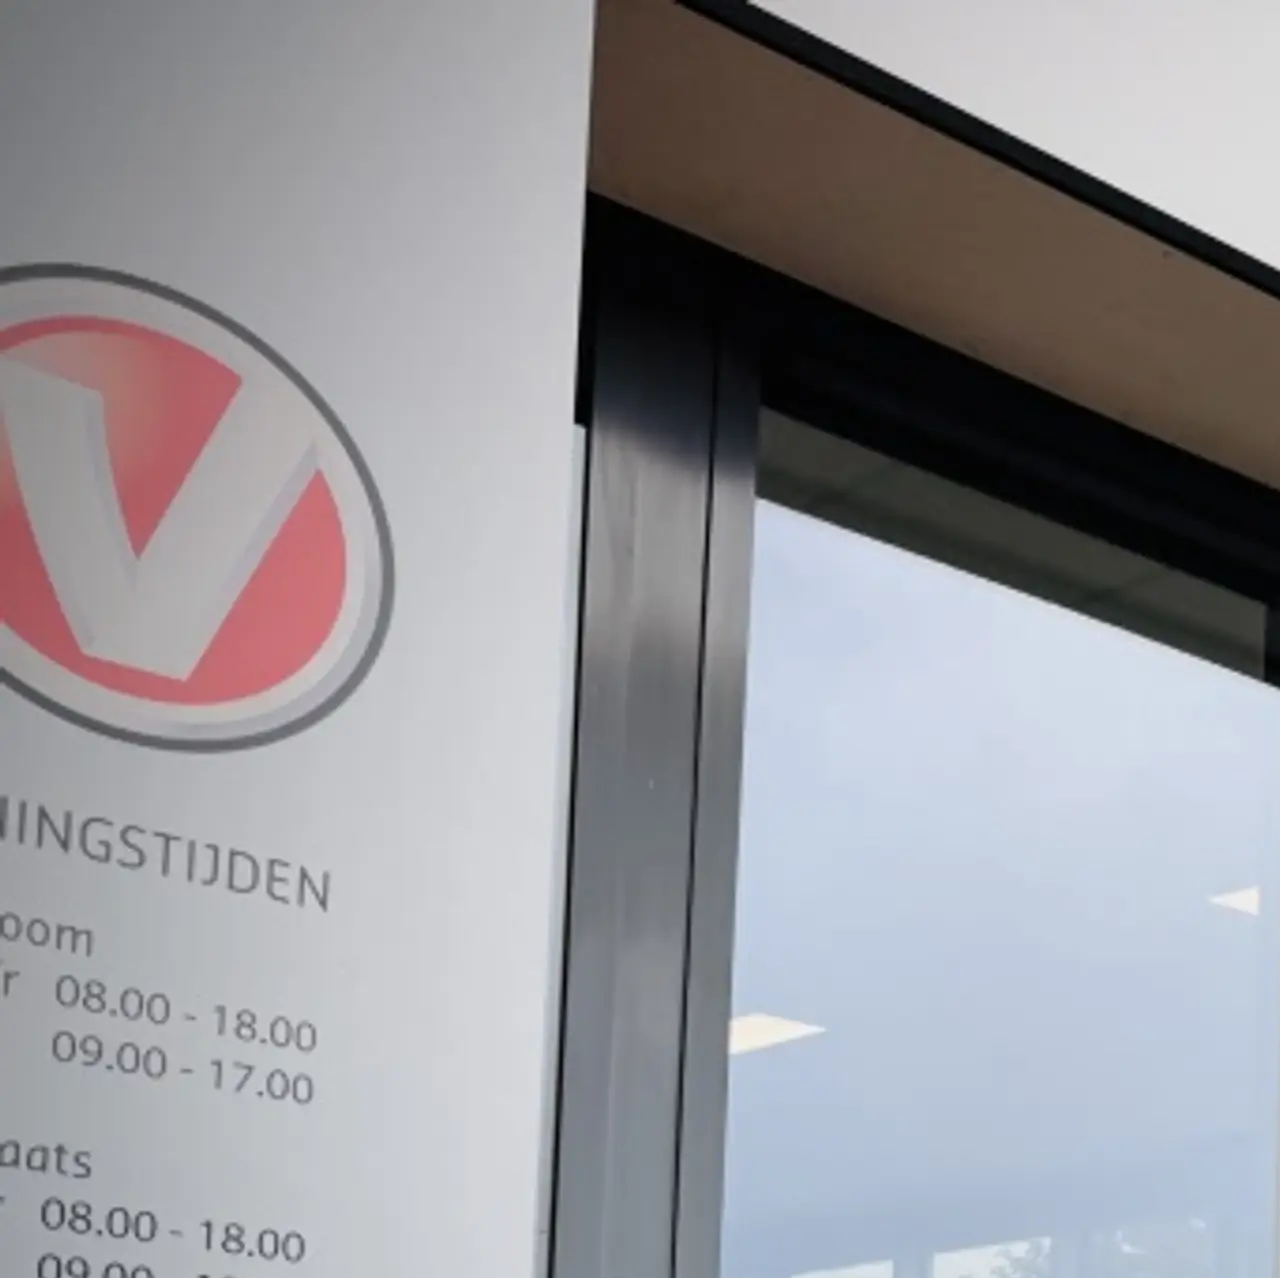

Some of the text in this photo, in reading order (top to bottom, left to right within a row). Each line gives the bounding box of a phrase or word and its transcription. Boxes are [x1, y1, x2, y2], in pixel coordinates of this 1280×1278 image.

[0, 794, 332, 912] INGSTIJDEN
[0, 912, 93, 957] oom
[55, 974, 170, 1026] 08.00
[213, 1004, 318, 1054] 18.00
[51, 1030, 167, 1080] 09.00
[210, 1059, 314, 1106] 17.00
[0, 1140, 91, 1178] aats
[40, 1196, 158, 1243] 08.00
[200, 1219, 306, 1265] 18.00
